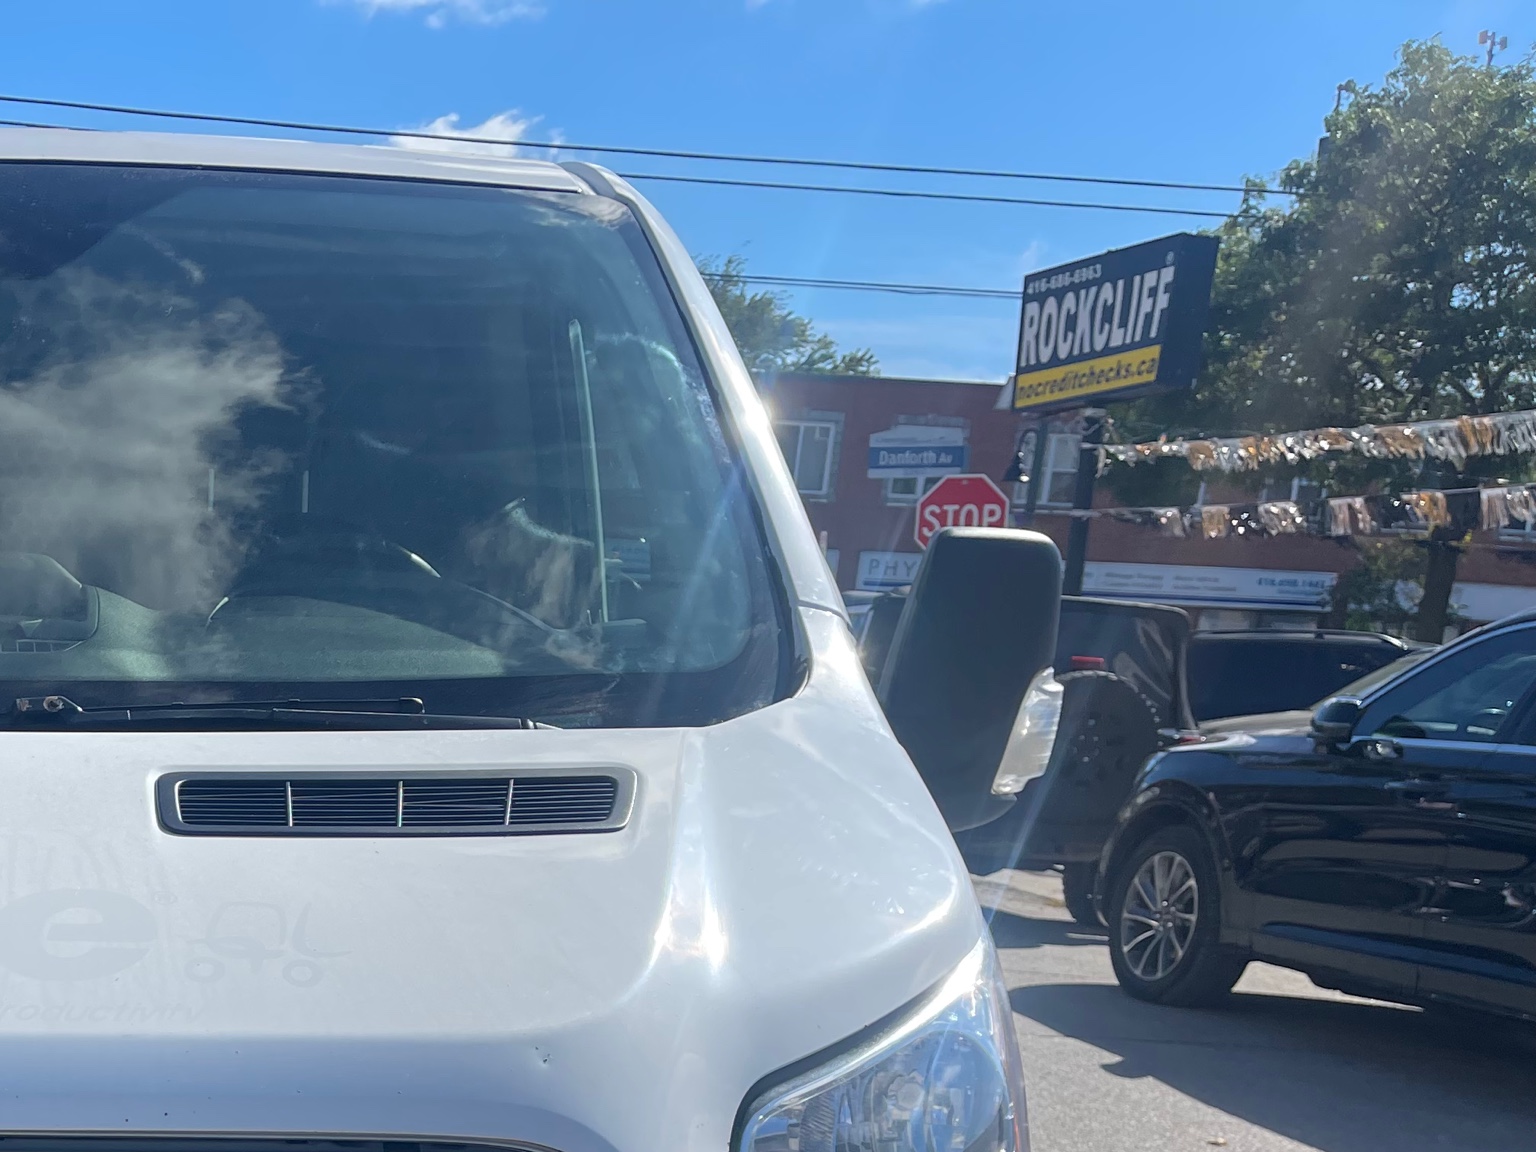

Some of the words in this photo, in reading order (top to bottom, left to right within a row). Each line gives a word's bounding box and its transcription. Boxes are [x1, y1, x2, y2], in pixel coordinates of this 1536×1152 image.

[1020, 265, 1175, 368] ROCKCLIFF
[1018, 357, 1158, 400] nocreditchecks.ca
[878, 450, 937, 466] Danforth
[921, 503, 1002, 537] STOP
